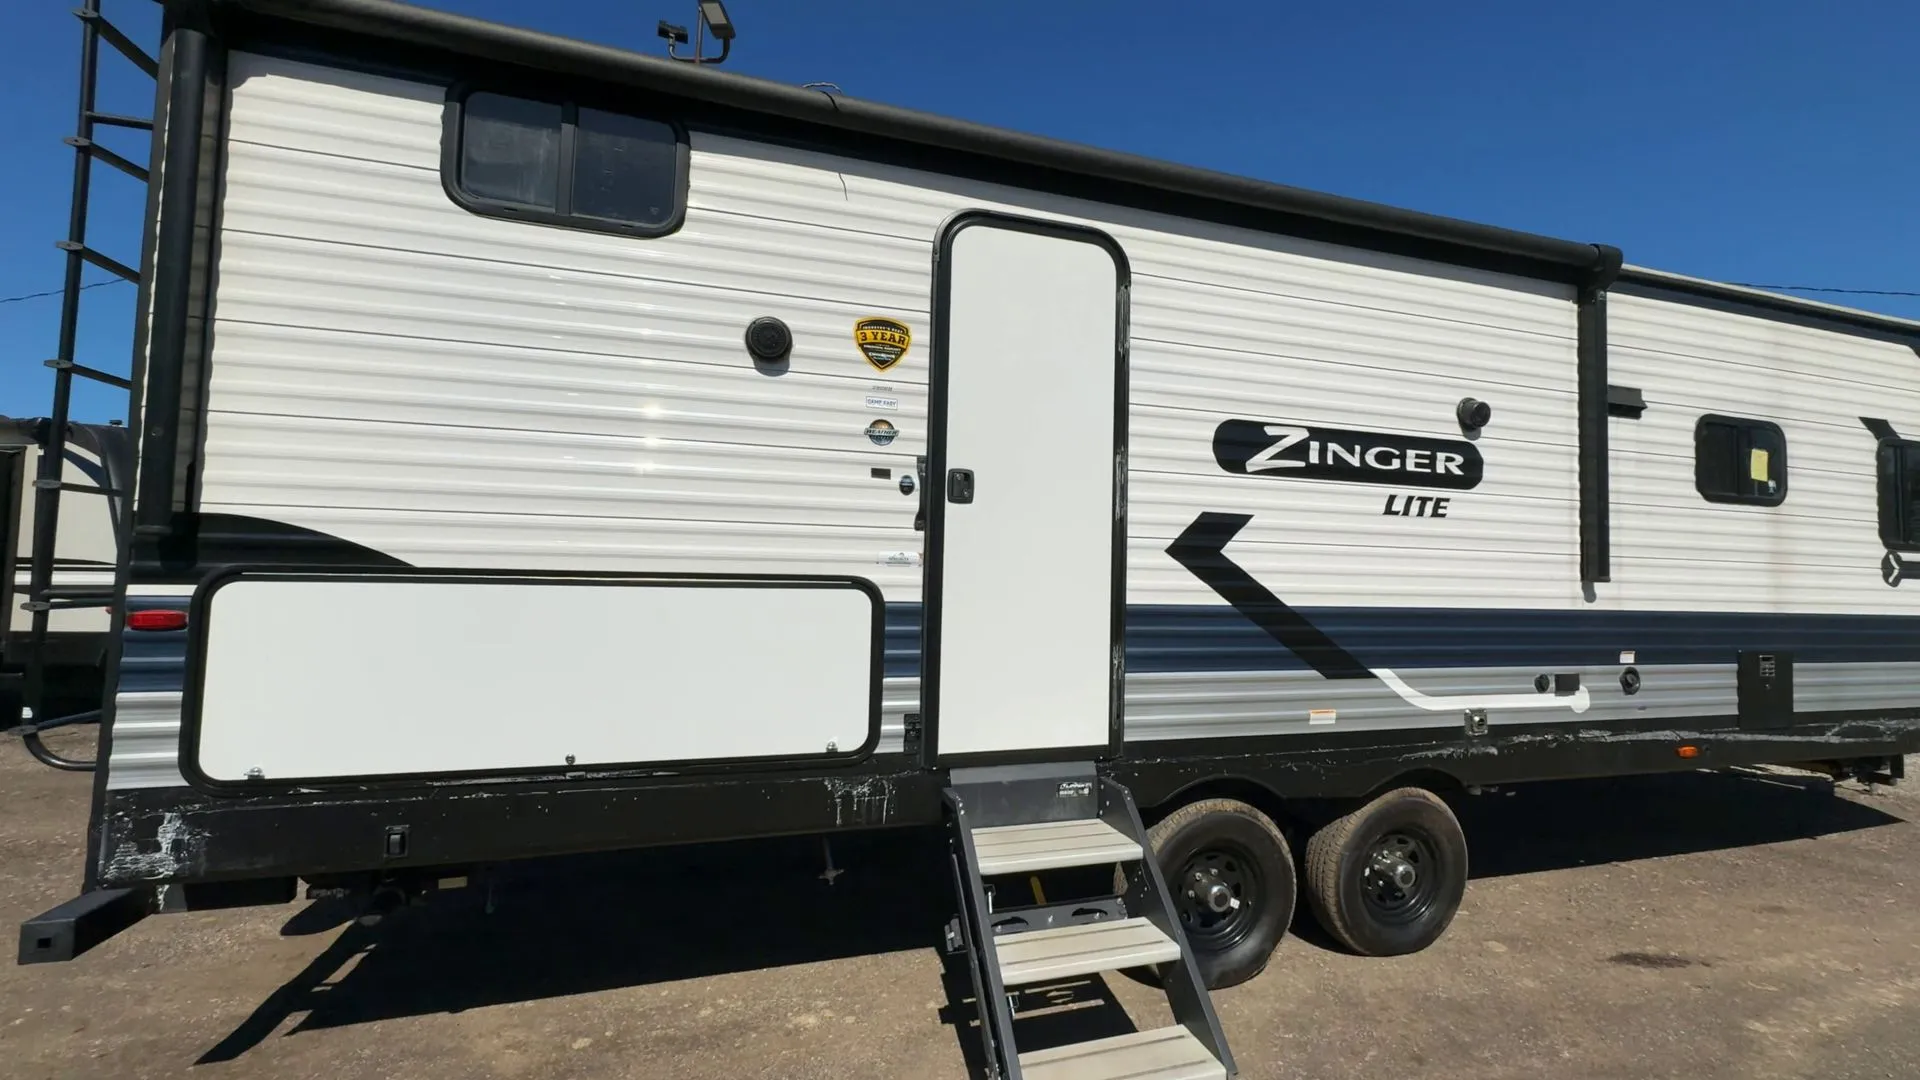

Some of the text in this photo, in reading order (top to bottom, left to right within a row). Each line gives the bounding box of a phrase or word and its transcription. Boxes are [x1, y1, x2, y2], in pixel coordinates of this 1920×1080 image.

[860, 331, 906, 346] 3 YEAR
[1245, 425, 1464, 476] ZINGER
[1382, 494, 1451, 518] LITE
